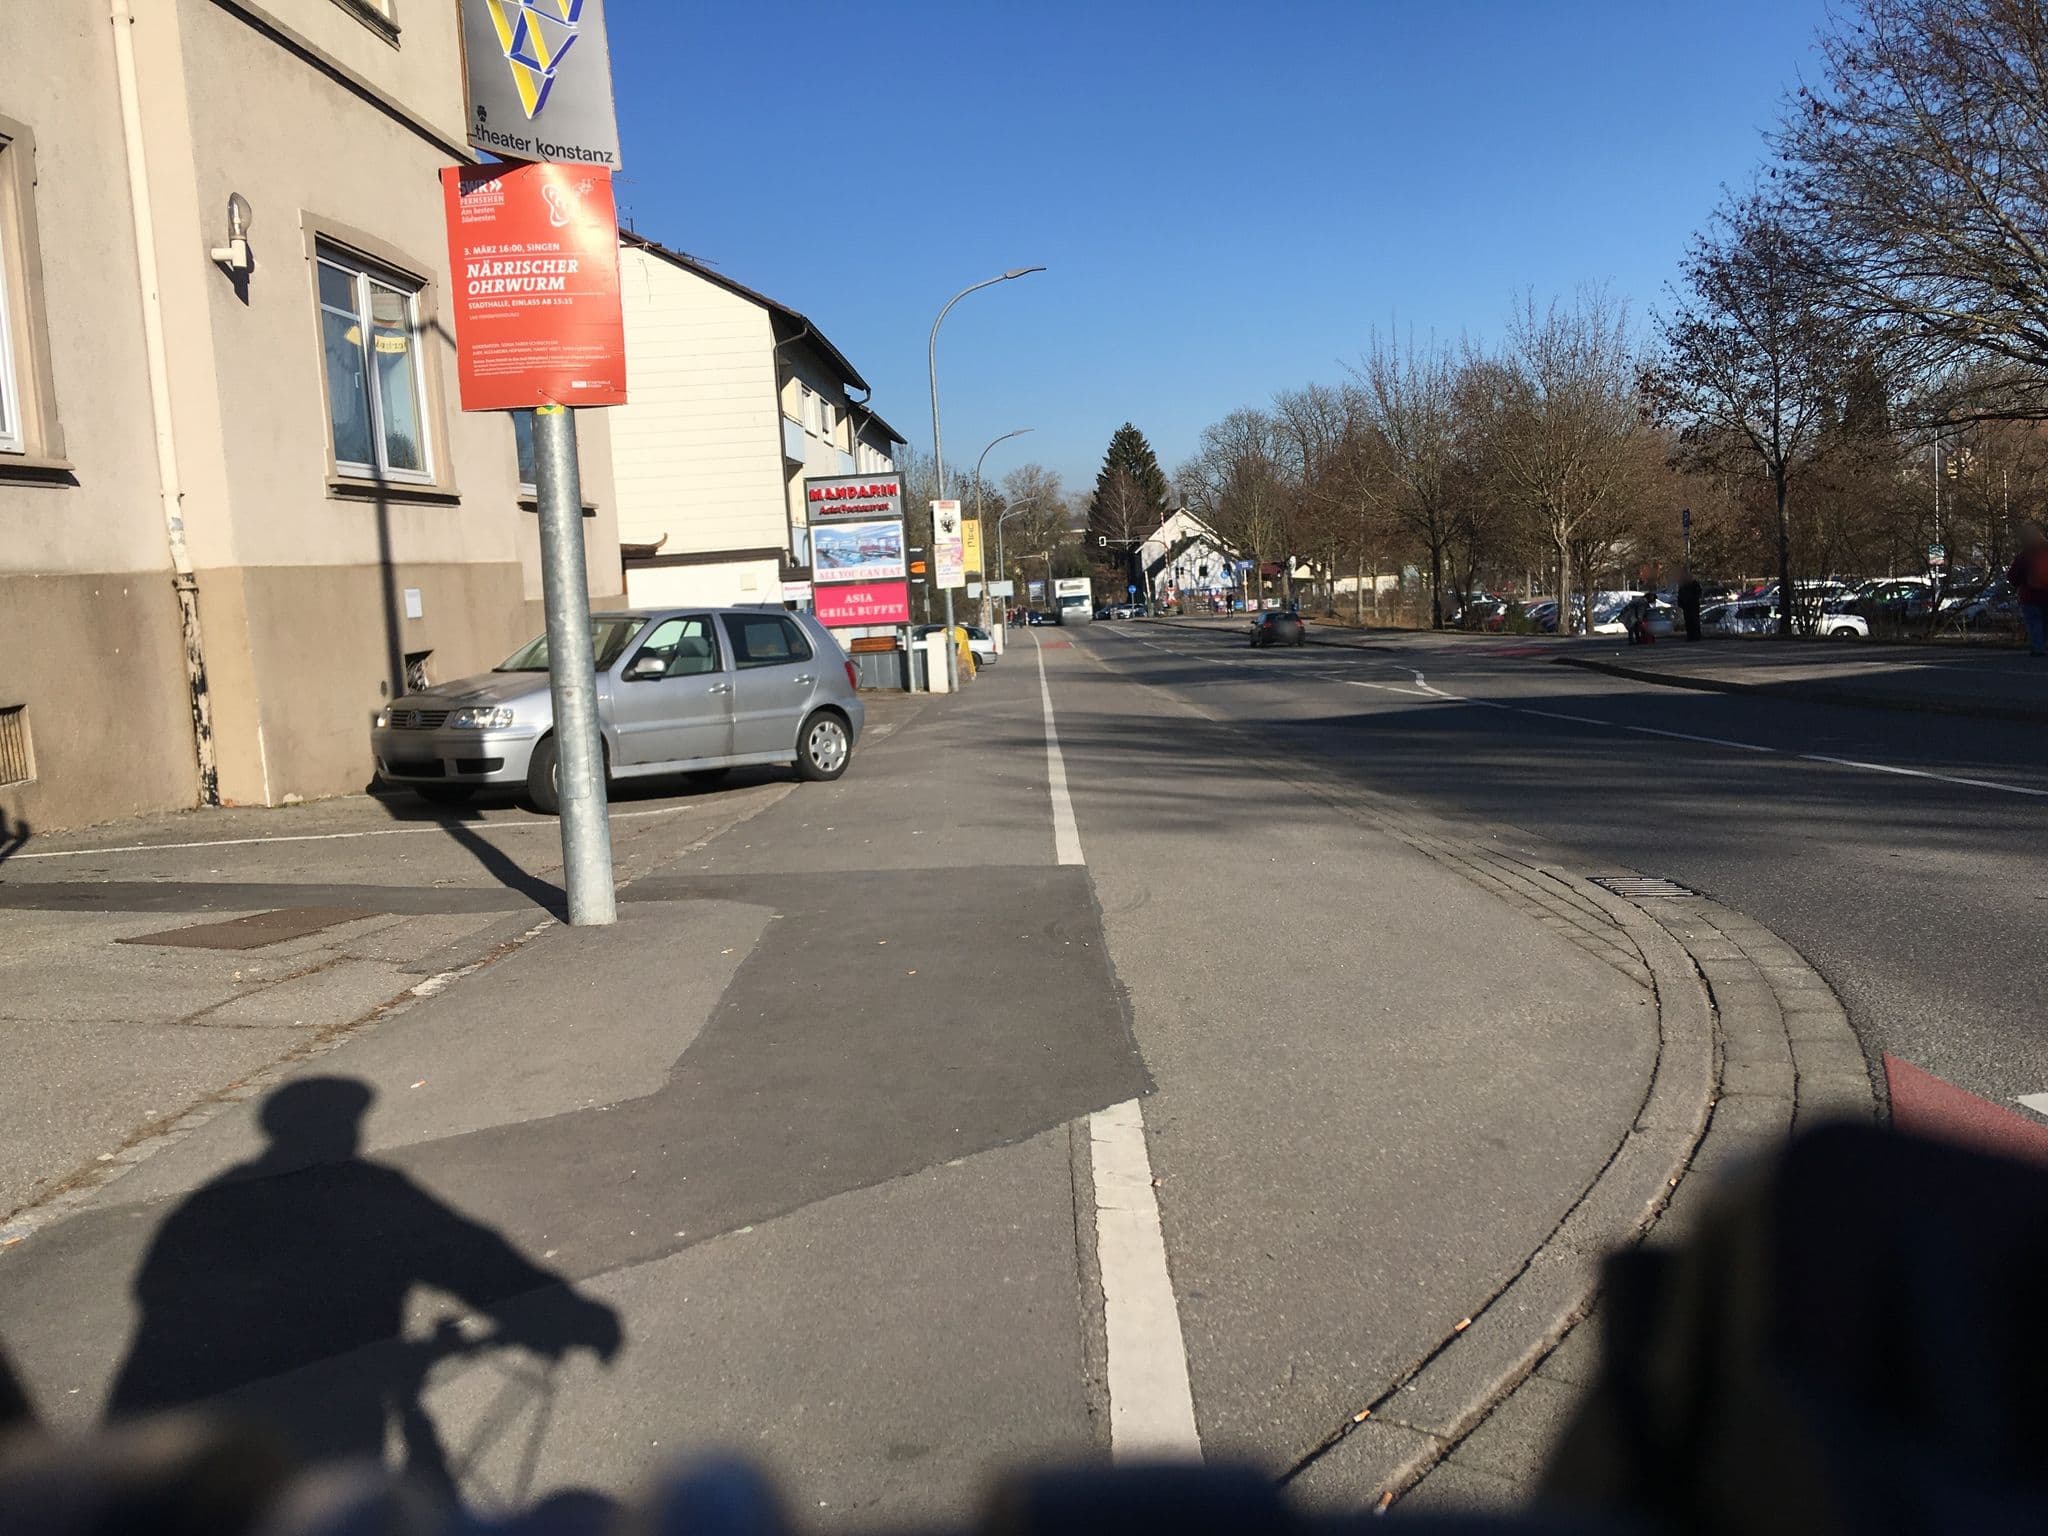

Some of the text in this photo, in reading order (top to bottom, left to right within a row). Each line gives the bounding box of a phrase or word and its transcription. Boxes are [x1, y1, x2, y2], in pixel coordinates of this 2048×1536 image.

[475, 124, 615, 164] theater konstanz
[460, 195, 505, 206] FERNSEHEN
[473, 244, 497, 255] MÄRZ
[527, 242, 560, 252] SINGEN
[466, 258, 579, 279] NÄRRISCHER
[468, 276, 566, 296] OHRWURM
[808, 483, 898, 502] MANDARIN
[819, 566, 903, 579] ALL YOU CAN EAT
[844, 593, 874, 604] ASIA
[819, 603, 904, 618] GRILL BUFFET
